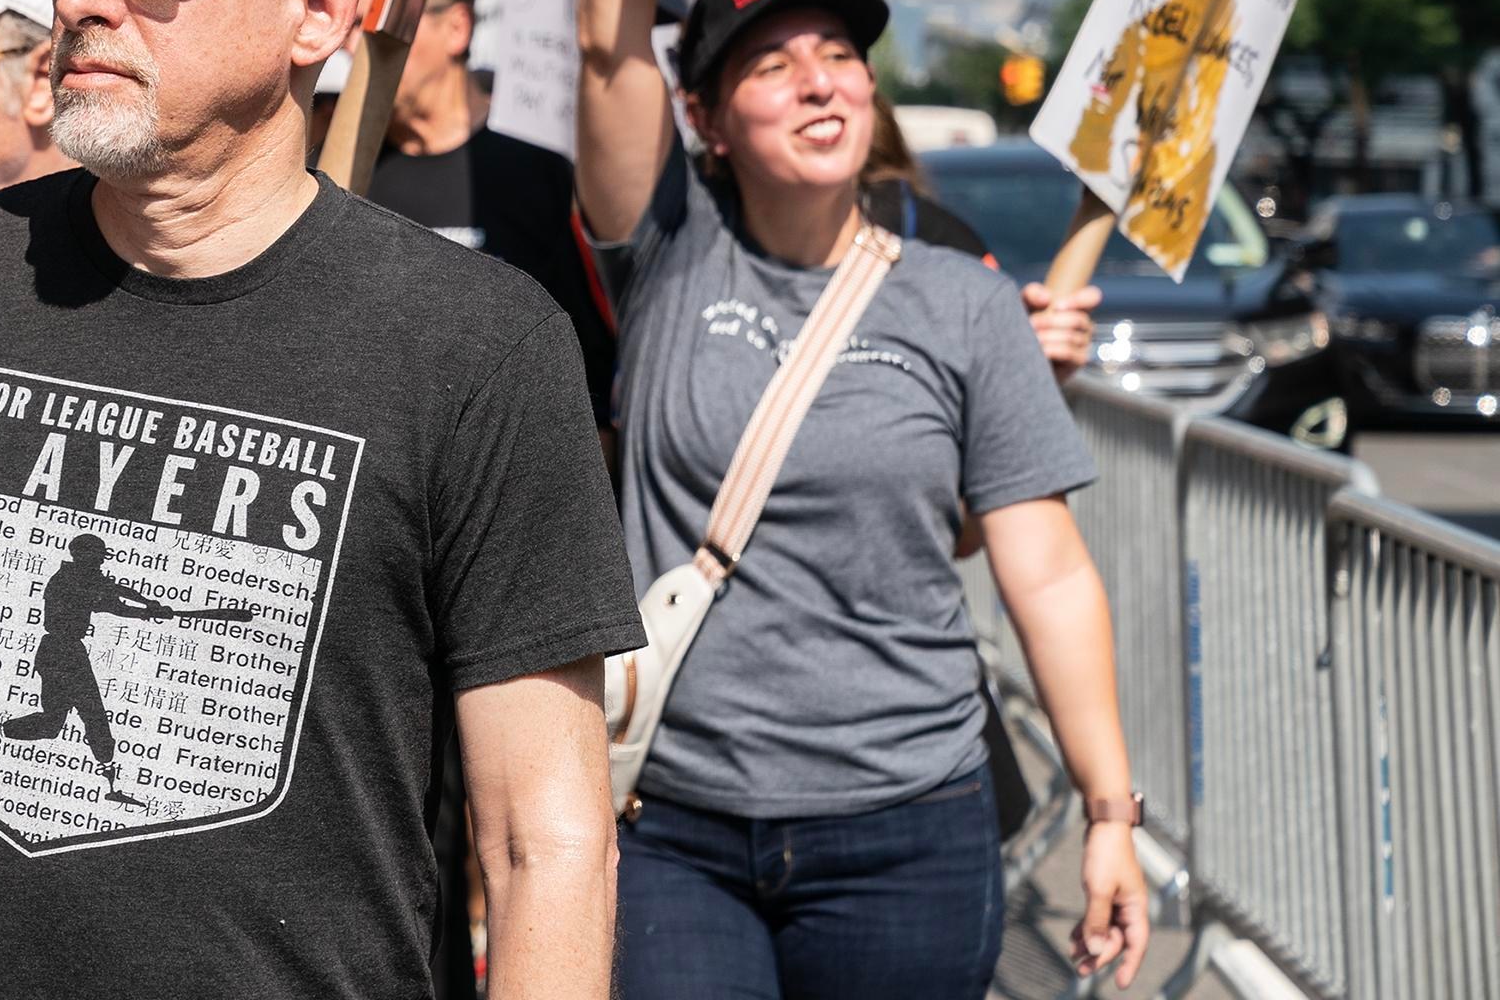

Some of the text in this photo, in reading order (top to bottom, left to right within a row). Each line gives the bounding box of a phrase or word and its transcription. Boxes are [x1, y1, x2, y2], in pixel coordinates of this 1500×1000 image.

[40, 393, 164, 444] LEAGUE
[174, 415, 337, 481] BASEBALL
[35, 502, 159, 543] Fraternidad
[155, 661, 295, 703] Fraternidade
[210, 645, 297, 678] Brother
[201, 697, 285, 727] Brother
